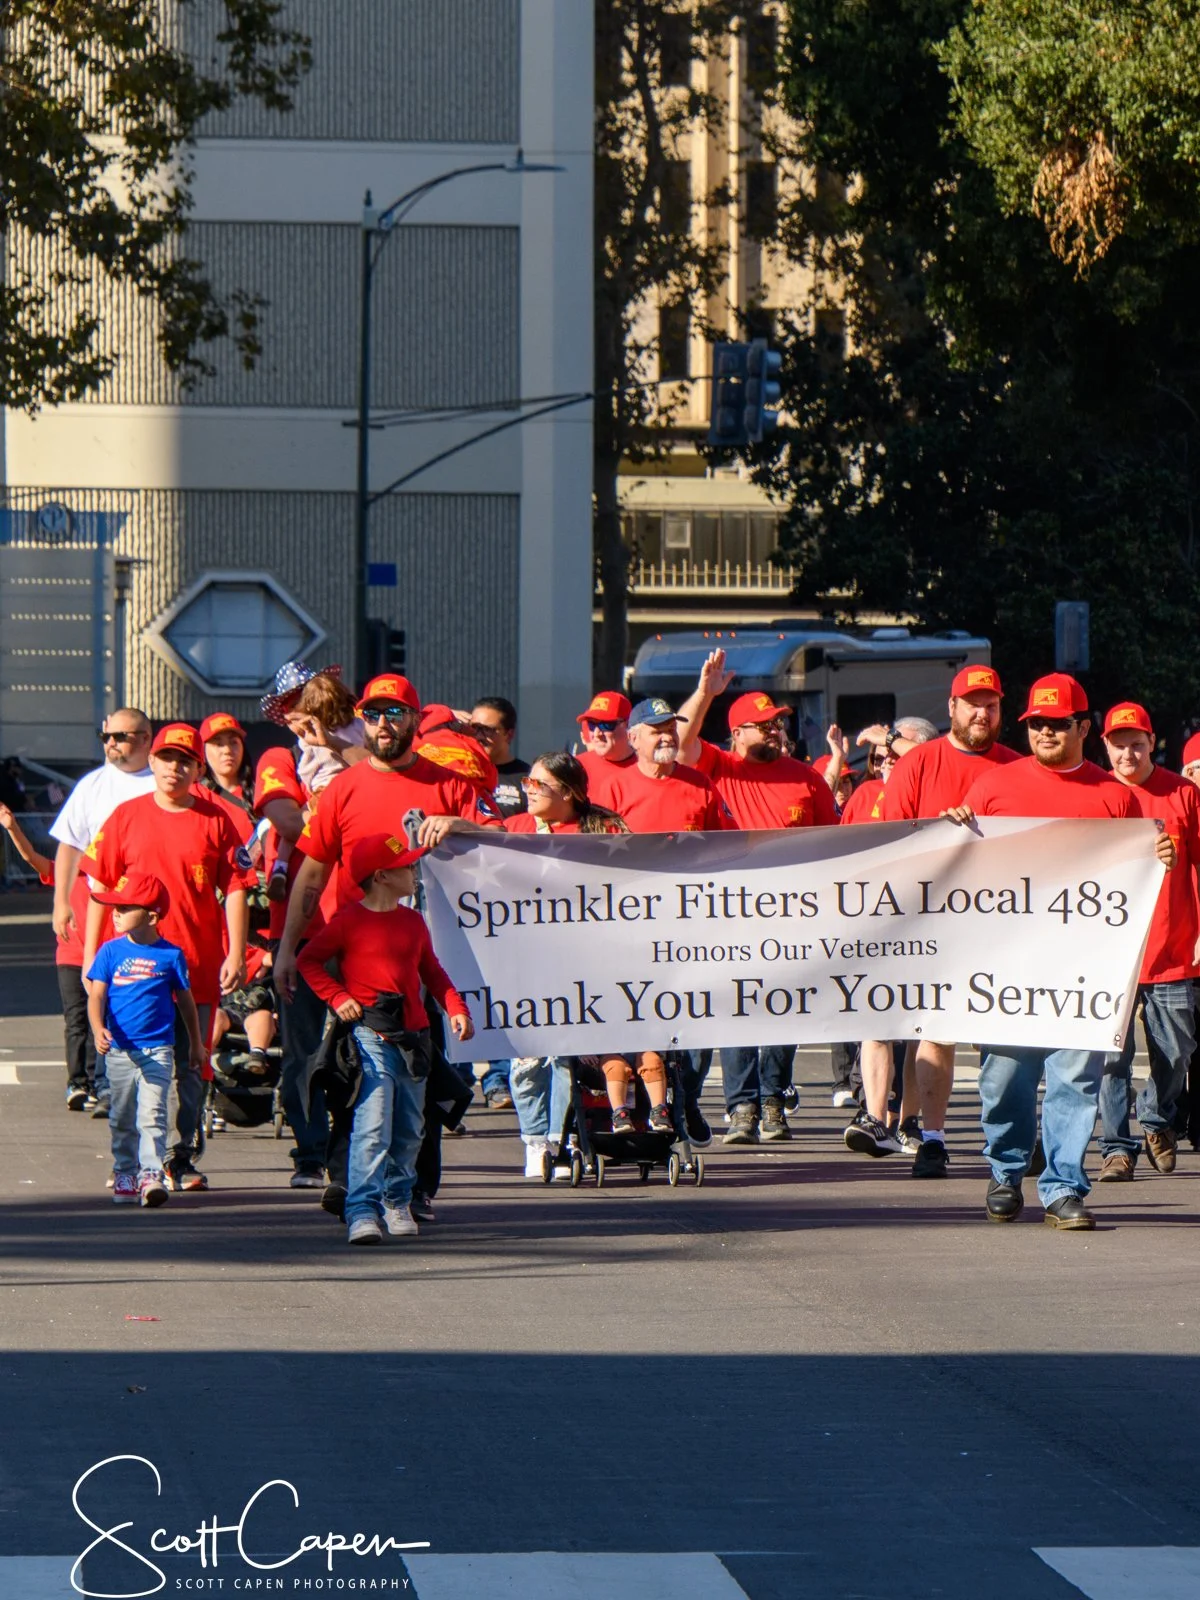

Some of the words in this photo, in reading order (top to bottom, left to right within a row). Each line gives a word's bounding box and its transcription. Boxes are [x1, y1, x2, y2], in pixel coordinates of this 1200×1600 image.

[457, 883, 662, 938] Sprinkler
[675, 881, 819, 919] Fitters
[833, 881, 906, 917] UA
[917, 877, 1034, 915] Local
[1047, 880, 1129, 926] 483
[651, 940, 751, 963] Honors
[760, 938, 812, 961] Our
[819, 935, 938, 960] Veterans
[616, 979, 715, 1023] You
[731, 977, 818, 1017] For
[829, 973, 953, 1014] Your
